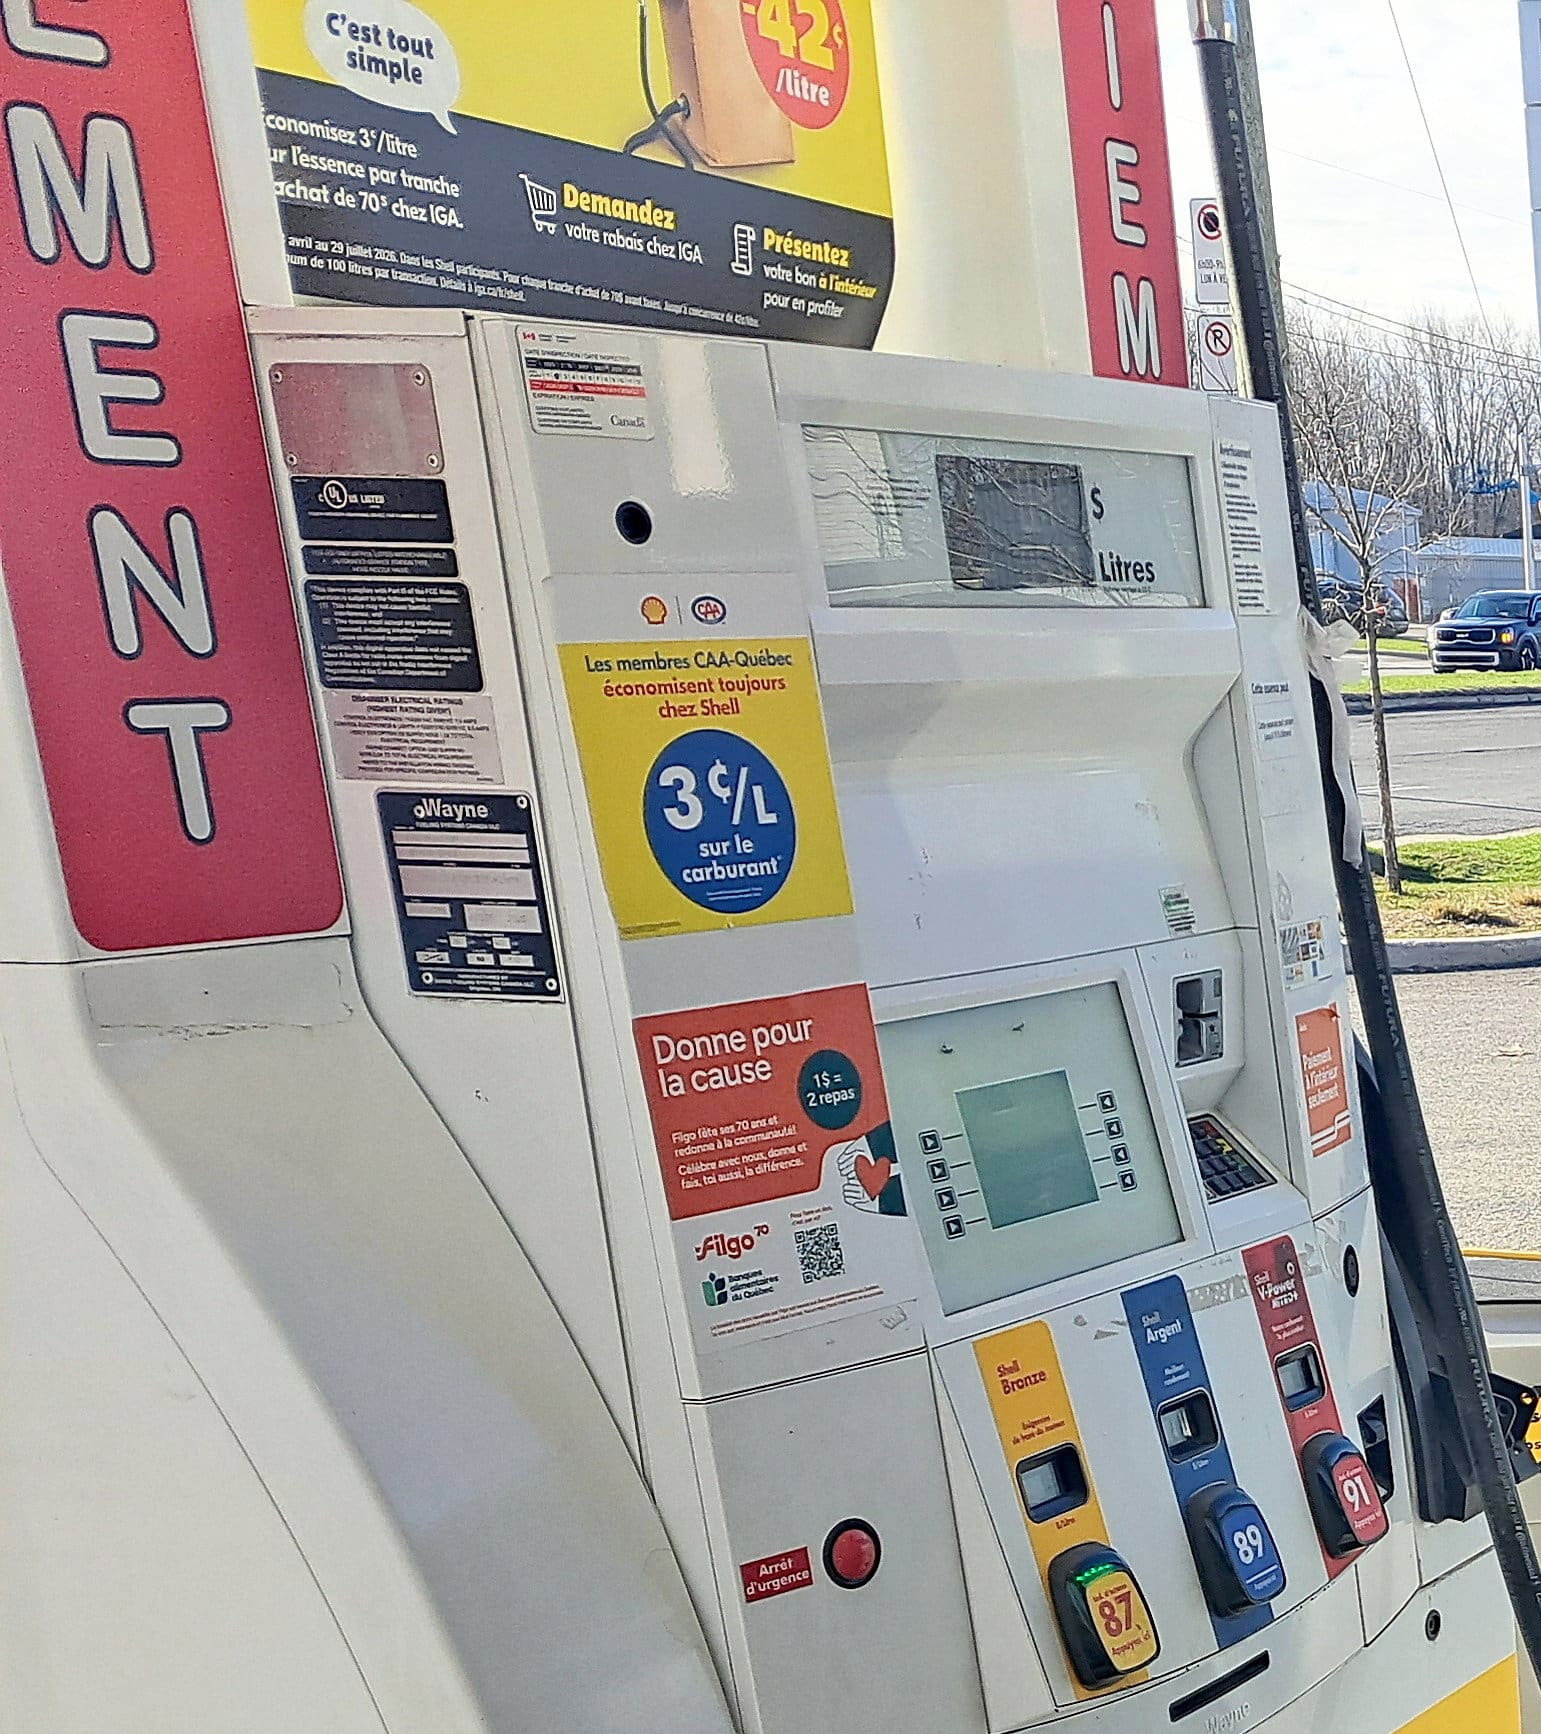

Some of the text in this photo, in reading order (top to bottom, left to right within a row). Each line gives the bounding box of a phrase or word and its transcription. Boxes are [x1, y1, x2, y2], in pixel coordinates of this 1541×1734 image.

[326, 12, 435, 59] C'est tout
[347, 45, 424, 85] simple
[776, 67, 831, 107] /litre
[262, 108, 357, 145] conomisez
[290, 146, 366, 178] l'essence
[369, 167, 397, 187] par
[400, 171, 460, 198] tranche
[333, 184, 356, 208] de
[391, 199, 427, 224] chez
[430, 204, 464, 229] IGA.
[562, 183, 676, 231] Demandez
[288, 235, 312, 249] avril
[314, 239, 329, 252] au
[330, 241, 344, 254] 29
[564, 222, 704, 265] votre rabais chez IGA
[763, 227, 850, 268] Présentez
[310, 257, 324, 269] de
[325, 258, 346, 273] 100
[347, 262, 373, 277] litres
[762, 263, 794, 283] votre
[795, 266, 817, 289] bon
[818, 271, 827, 290] à
[763, 290, 846, 319] pour en profiter
[1099, 552, 1155, 585] Litres
[698, 603, 720, 619] CAA
[585, 648, 792, 673] Les membres CAA-Québec
[603, 675, 786, 697] économisent toujours
[658, 698, 740, 718] chez Shell
[699, 834, 754, 858] sur le
[651, 1017, 814, 1065] Donne pour
[658, 1056, 773, 1098] la cause
[807, 1087, 856, 1108] 2 repas
[672, 1131, 697, 1145] Filgo
[736, 1120, 750, 1132] 70
[674, 1143, 716, 1157] redonne
[724, 1137, 733, 1148] la
[745, 1166, 755, 1177] la
[753, 1223, 770, 1237] 70
[728, 1269, 763, 1283] Banques
[729, 1276, 780, 1293] alimentaires
[731, 1285, 775, 1302] du Québec
[1147, 1319, 1183, 1344] Argent
[997, 1360, 1020, 1378] Shell
[1001, 1370, 1047, 1395] Bronze
[1342, 1475, 1371, 1513] 91
[1233, 1524, 1264, 1565] 89
[759, 1557, 794, 1578] Arrêt
[746, 1569, 810, 1596] d'urgence
[1099, 1590, 1132, 1638] 87
